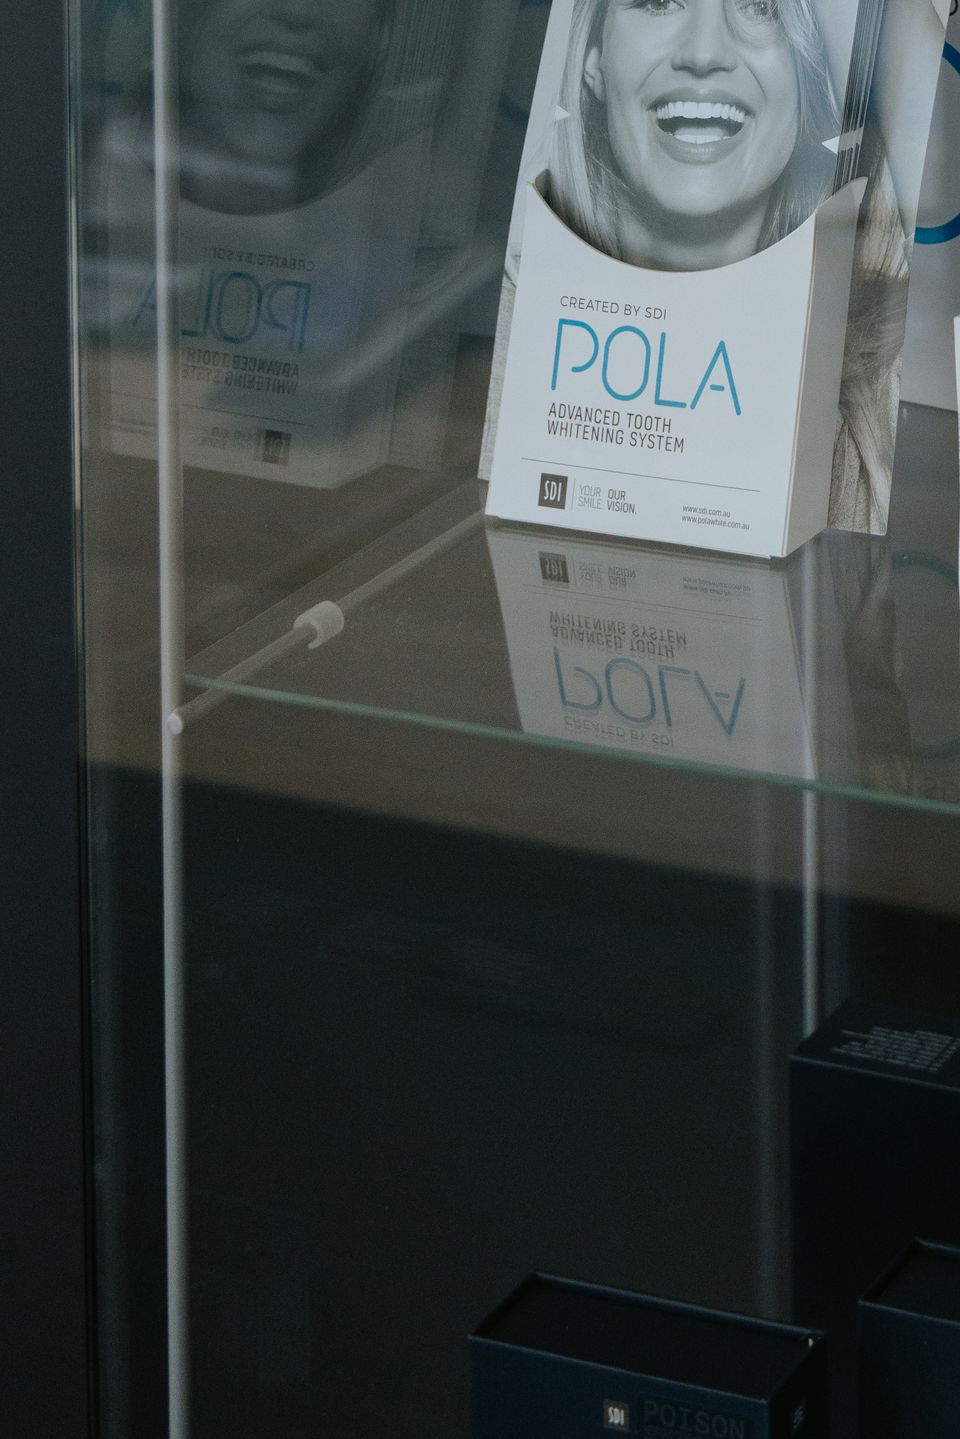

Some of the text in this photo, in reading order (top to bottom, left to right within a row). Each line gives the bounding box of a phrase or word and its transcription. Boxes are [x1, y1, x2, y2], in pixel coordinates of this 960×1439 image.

[560, 295, 667, 320] CREATED BY SDI
[550, 318, 742, 416] POLA
[548, 402, 672, 434] ADVANCED TOOTH
[547, 419, 685, 453] WHITENING SYSTEM
[543, 479, 562, 503] SDI
[579, 484, 626, 501] YOUR OUR
[578, 495, 637, 515] SMILE VISION.
[682, 504, 731, 518] www.sdi.com.au
[681, 514, 750, 530] www.polawhite.com.au
[607, 1405, 625, 1427] SDI
